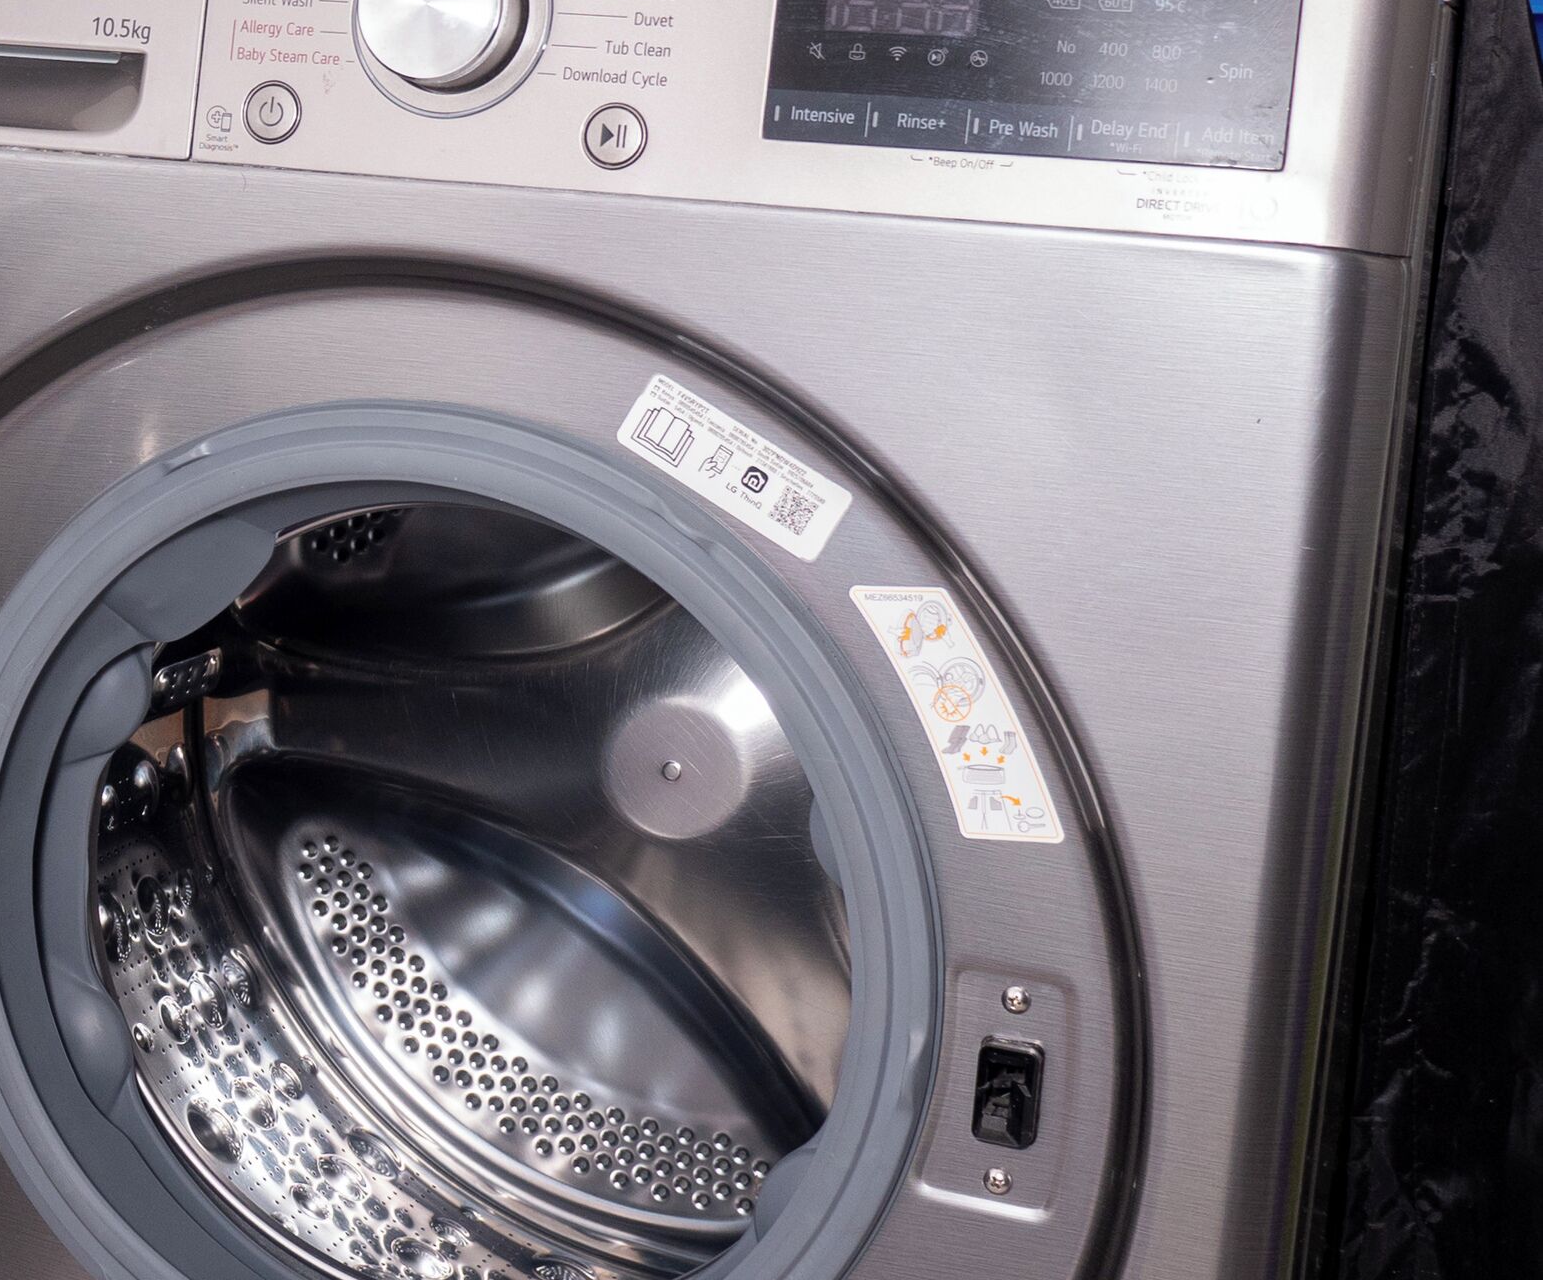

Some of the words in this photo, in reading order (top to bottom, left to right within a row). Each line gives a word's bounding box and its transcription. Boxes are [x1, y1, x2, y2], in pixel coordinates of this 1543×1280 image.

[240, 20, 282, 38] Allergy
[286, 22, 314, 36] Care
[634, 12, 674, 28] Duvet
[91, 16, 151, 44] 10.5kg
[237, 47, 266, 64] Baby
[270, 49, 308, 64] Steam
[311, 51, 340, 66] Care
[605, 40, 629, 55] Tub
[634, 42, 671, 58] Clean
[1057, 40, 1076, 54] No
[1098, 42, 1128, 57] 400
[1152, 44, 1182, 60] 800
[562, 67, 627, 84] Download
[632, 70, 668, 89] Cycle
[1219, 62, 1254, 81] Spin
[1039, 71, 1073, 87] 1000
[1092, 74, 1124, 90] 1200
[1144, 77, 1178, 93] 1400
[791, 105, 855, 125] Intensive
[897, 113, 947, 130] Rinse+
[988, 119, 1014, 136] Pre
[1018, 121, 1058, 138] Wash
[1091, 119, 1133, 140] Delay
[1138, 122, 1168, 139] End
[1202, 127, 1234, 143] Add
[1238, 129, 1275, 145] Item
[960, 158, 995, 170] On/Off
[1136, 198, 1180, 211] DIRECT
[725, 482, 737, 494] LG
[738, 490, 763, 511] ThinQ
